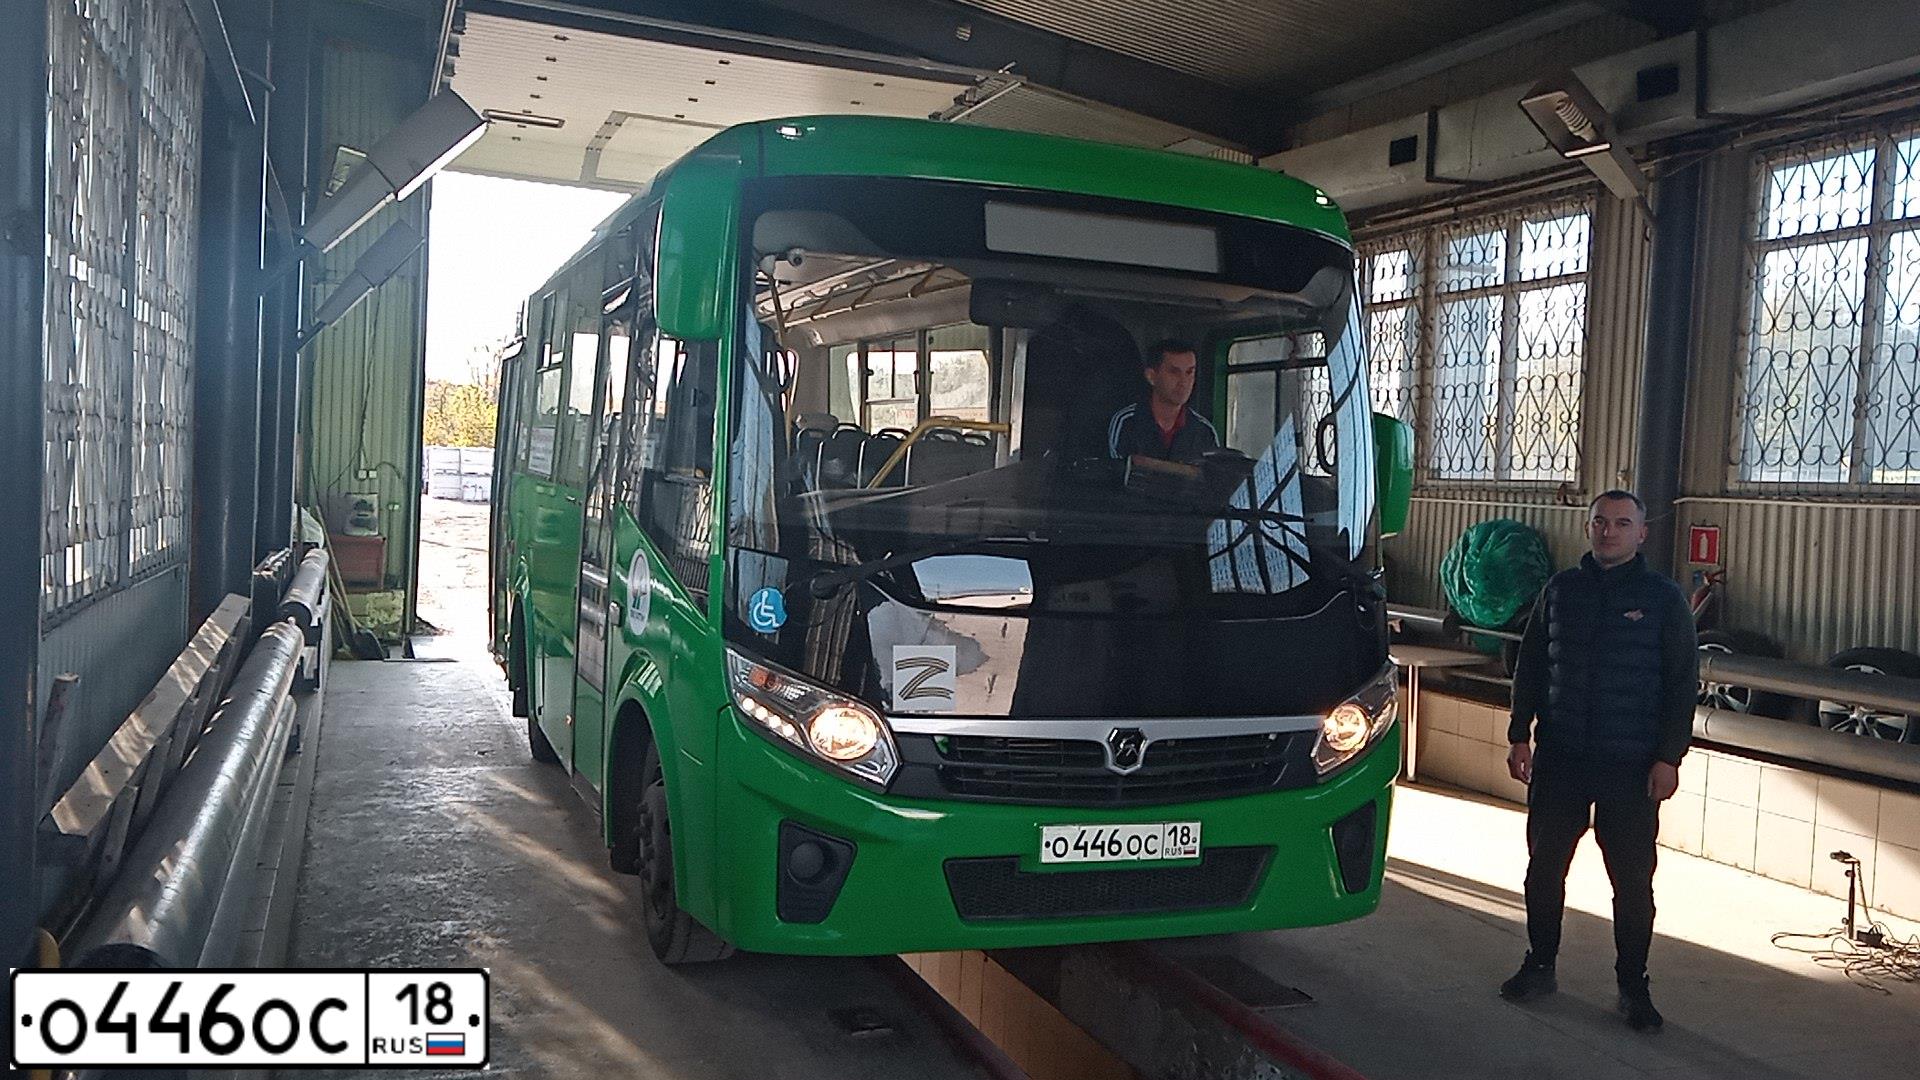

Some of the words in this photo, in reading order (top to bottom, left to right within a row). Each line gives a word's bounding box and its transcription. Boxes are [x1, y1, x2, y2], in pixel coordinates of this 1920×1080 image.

[895, 657, 954, 700] Z
[1167, 825, 1191, 847] 18
[1164, 847, 1183, 856] RUS
